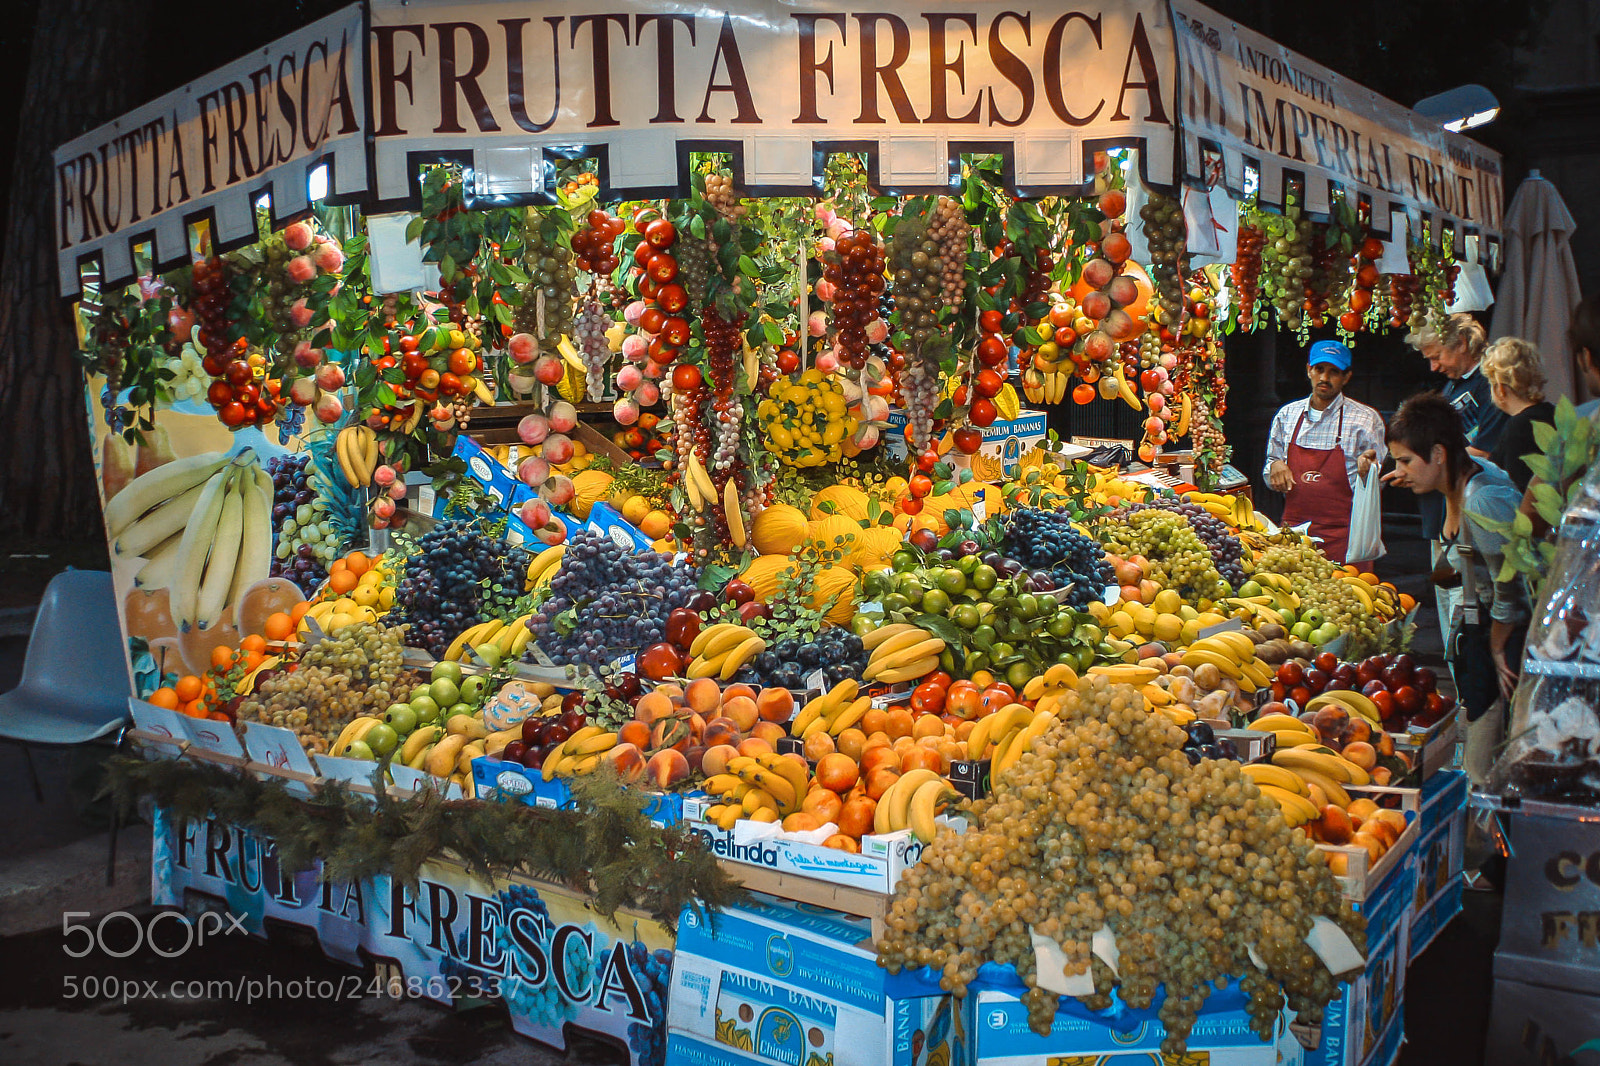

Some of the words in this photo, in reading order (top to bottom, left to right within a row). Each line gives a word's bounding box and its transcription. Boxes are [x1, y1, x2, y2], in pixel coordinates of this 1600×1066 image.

[56, 109, 190, 249] FRUTTA
[197, 28, 360, 195] FRESCA
[370, 11, 763, 135] FRUTTA
[790, 11, 1171, 127] FRESCA
[1238, 81, 1403, 194] IMPERIAL
[1406, 153, 1474, 221] FRUIT
[1013, 421, 1041, 434] BANANAS
[384, 876, 653, 1028] FRESCA
[759, 1040, 800, 1065] Chiquita
